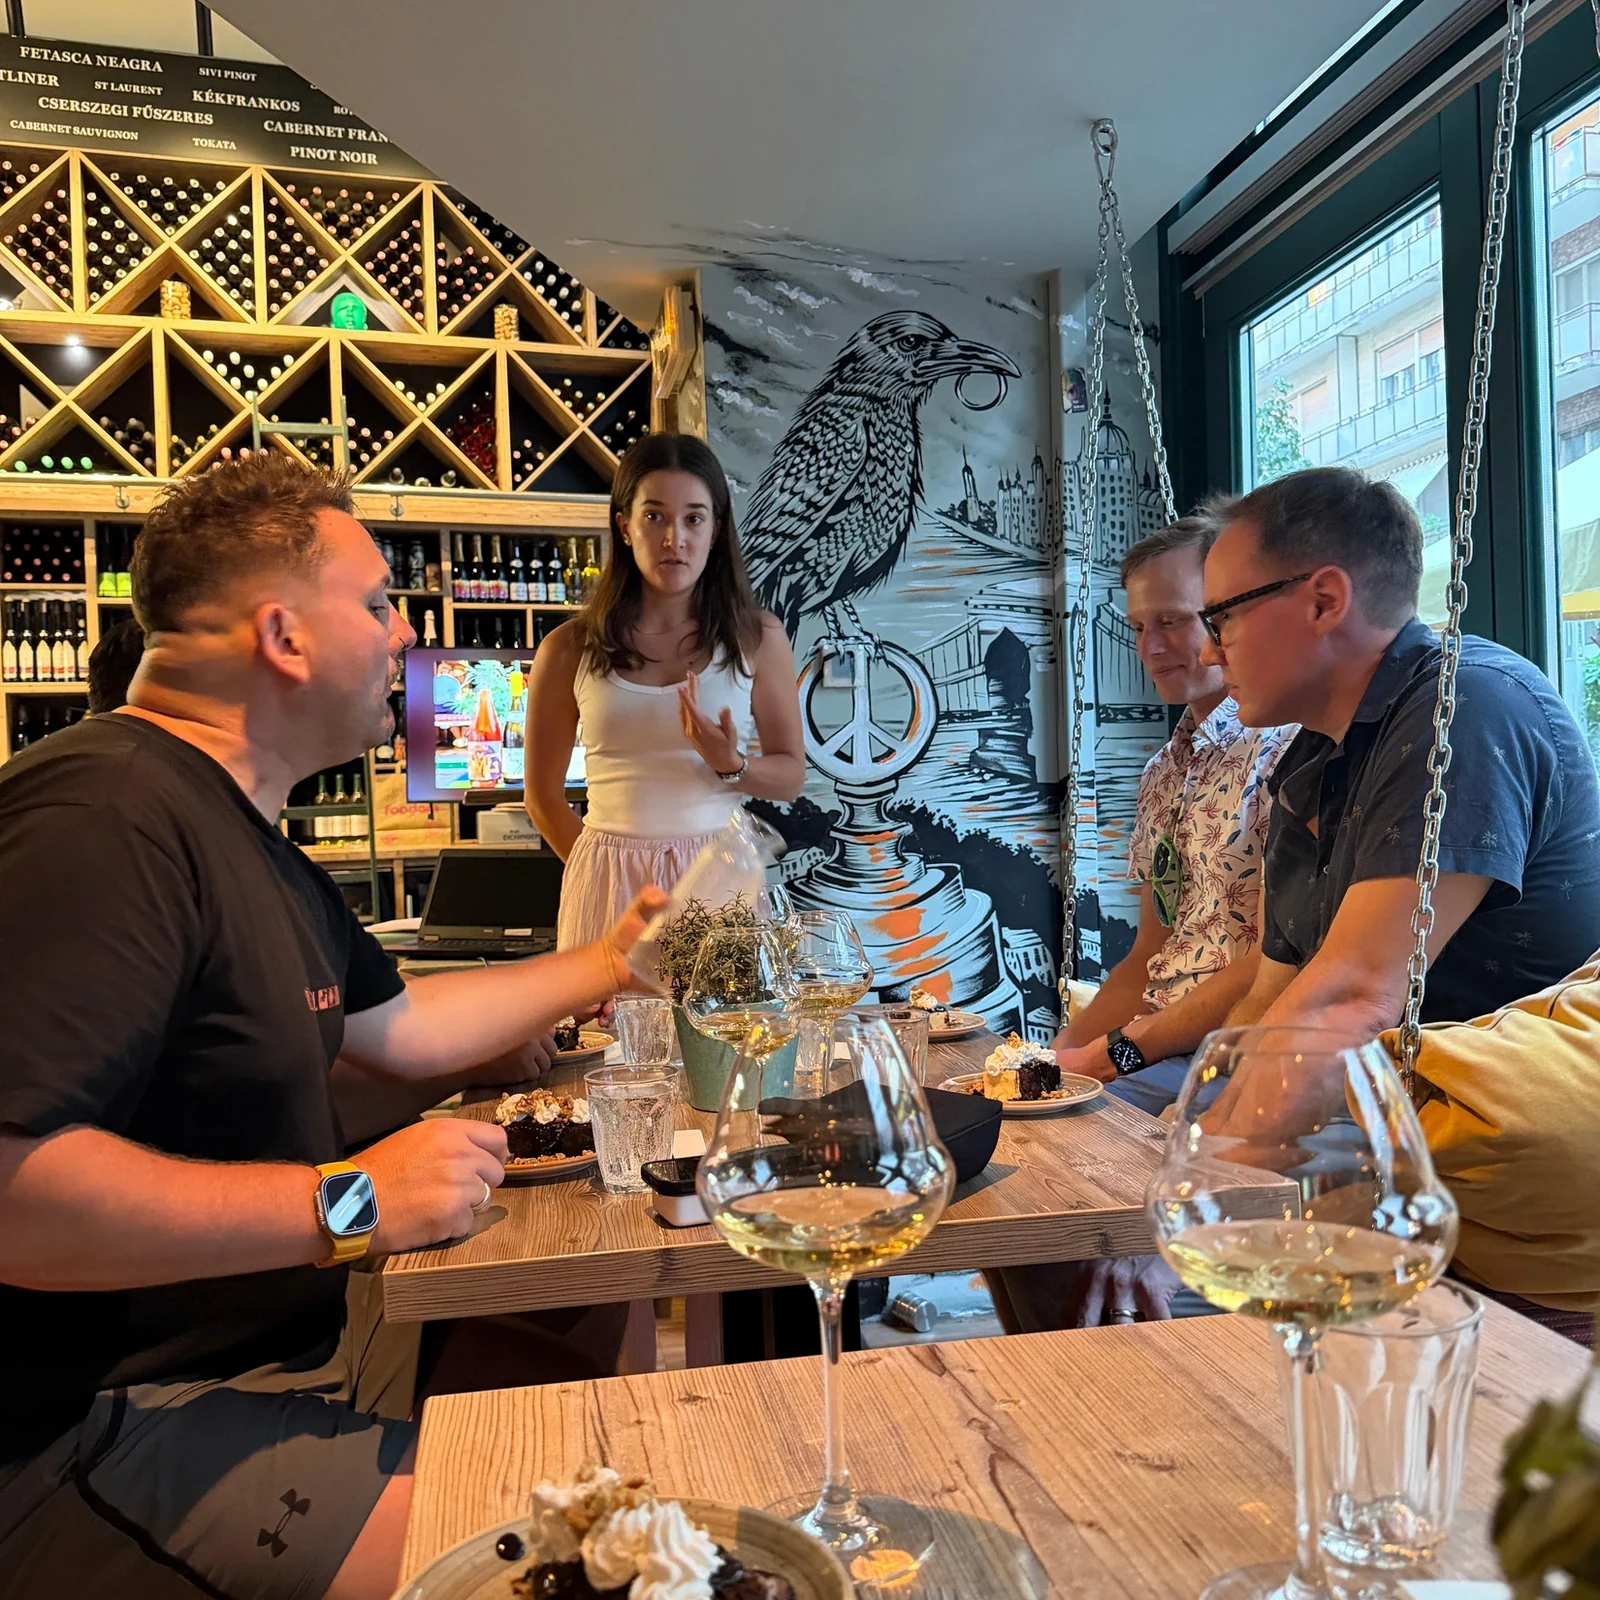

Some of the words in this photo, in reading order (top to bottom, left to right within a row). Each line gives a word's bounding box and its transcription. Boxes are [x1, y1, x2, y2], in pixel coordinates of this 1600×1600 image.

[20, 46, 93, 65] FETASCA
[95, 55, 163, 72] NEAGRA
[199, 67, 222, 78] SIVI
[224, 71, 257, 81] PINOT
[94, 81, 109, 90] ST
[111, 83, 163, 95] LAURENT
[192, 89, 300, 112] KÉKFRANKOS
[38, 97, 128, 116] CSERSZEGI
[132, 105, 213, 125] FŰSZERES
[10, 120, 72, 134] CABERNET
[73, 126, 138, 140] SAUVIGNON
[264, 120, 345, 138] CABERNET
[348, 128, 393, 143] FRAN
[192, 138, 236, 150] TOKATA
[290, 146, 337, 160] PINOT
[339, 152, 378, 165] NOIR
